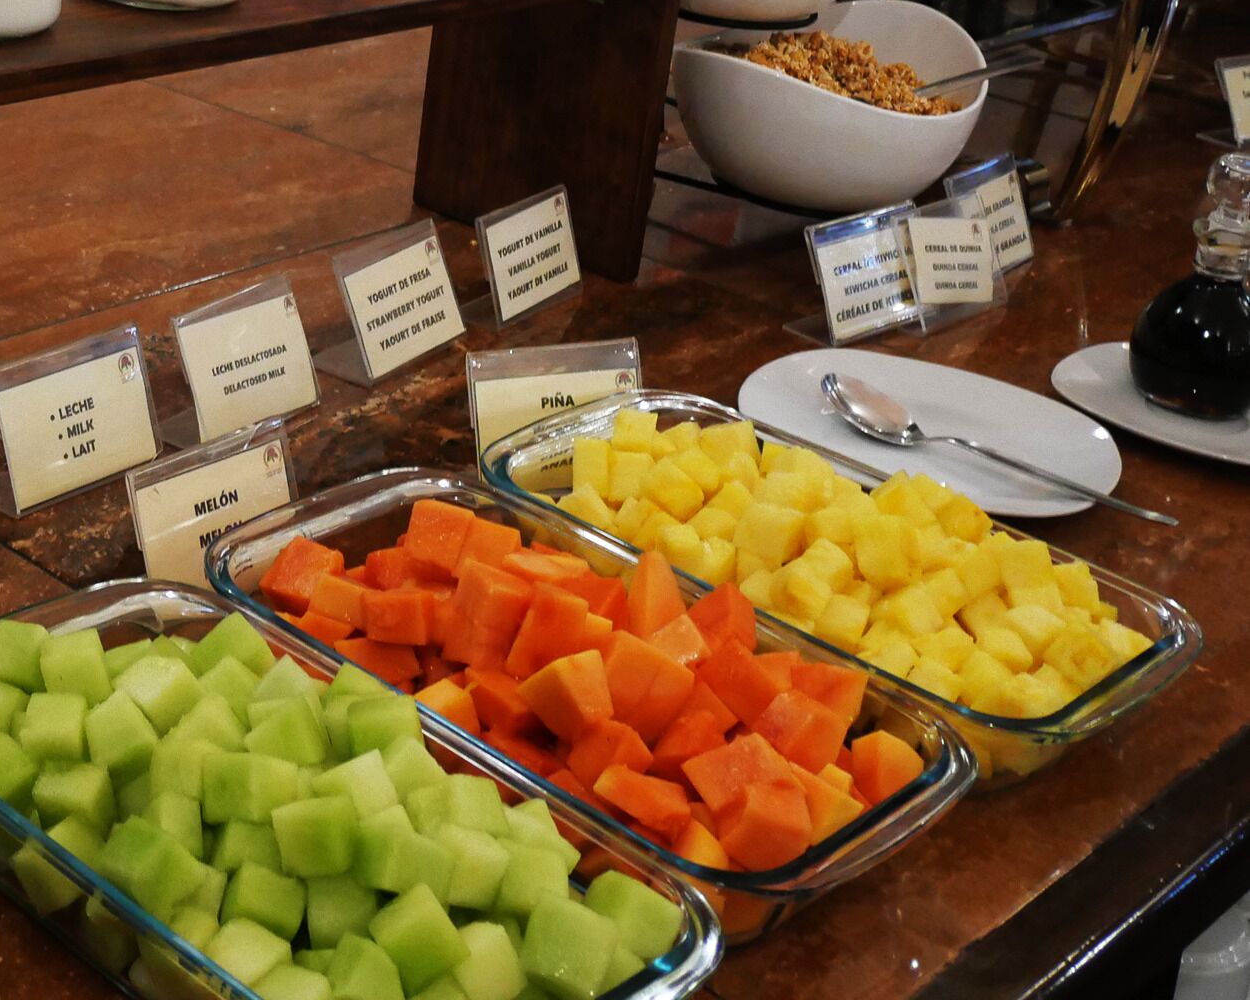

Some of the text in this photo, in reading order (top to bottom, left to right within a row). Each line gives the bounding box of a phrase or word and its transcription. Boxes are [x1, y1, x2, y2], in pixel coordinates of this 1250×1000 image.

[497, 220, 563, 259] YOGURT DE VAINILLA
[924, 244, 948, 253] CEREAL
[949, 244, 958, 253] DE
[508, 243, 561, 278] VANILLA YOGURT
[957, 263, 979, 272] CEREAL
[367, 267, 432, 306] YOGURT DE FRESA
[507, 261, 568, 301] YAOURT DE VANILLE
[844, 269, 908, 296] KIWICHA CEREAL
[958, 281, 979, 290] CEREAL
[366, 285, 445, 333] STRAWBERRY YOGURT
[836, 298, 884, 323] CÉRÉALE DE
[379, 310, 447, 351] YAOURT DE FRAISE
[211, 344, 288, 377] LECHE DESLACTOSADA
[223, 366, 286, 396] DELACTOSED MILK
[58, 397, 95, 420] LECHE
[541, 391, 575, 409] PIÑA
[66, 418, 95, 439] MILK
[71, 439, 96, 459] LAIT
[193, 489, 239, 517] MELÓN
